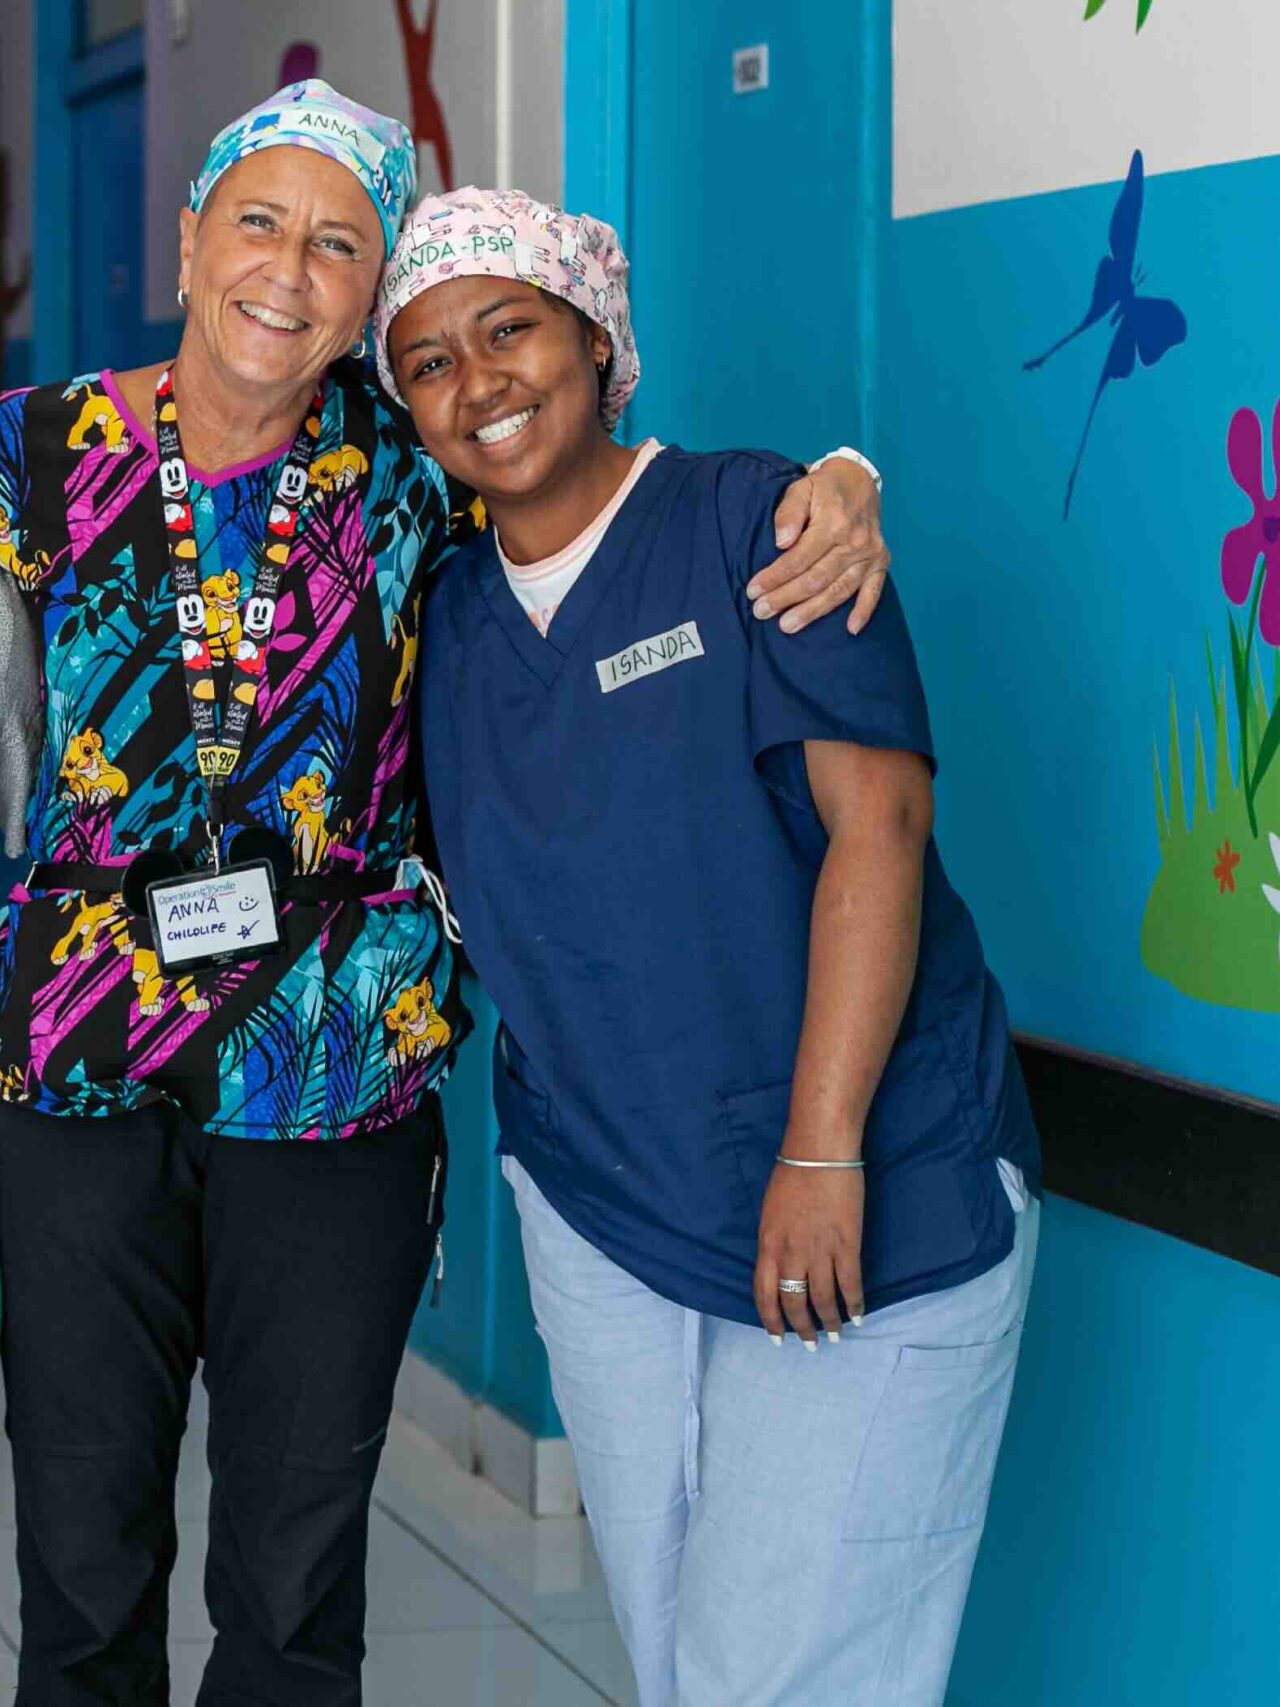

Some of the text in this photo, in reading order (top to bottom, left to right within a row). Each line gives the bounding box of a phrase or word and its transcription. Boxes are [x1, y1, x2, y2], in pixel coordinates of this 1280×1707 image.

[299, 113, 360, 147] ANNA
[611, 631, 696, 681] ISANDA
[220, 752, 236, 767] 90
[168, 897, 220, 923] ANNA
